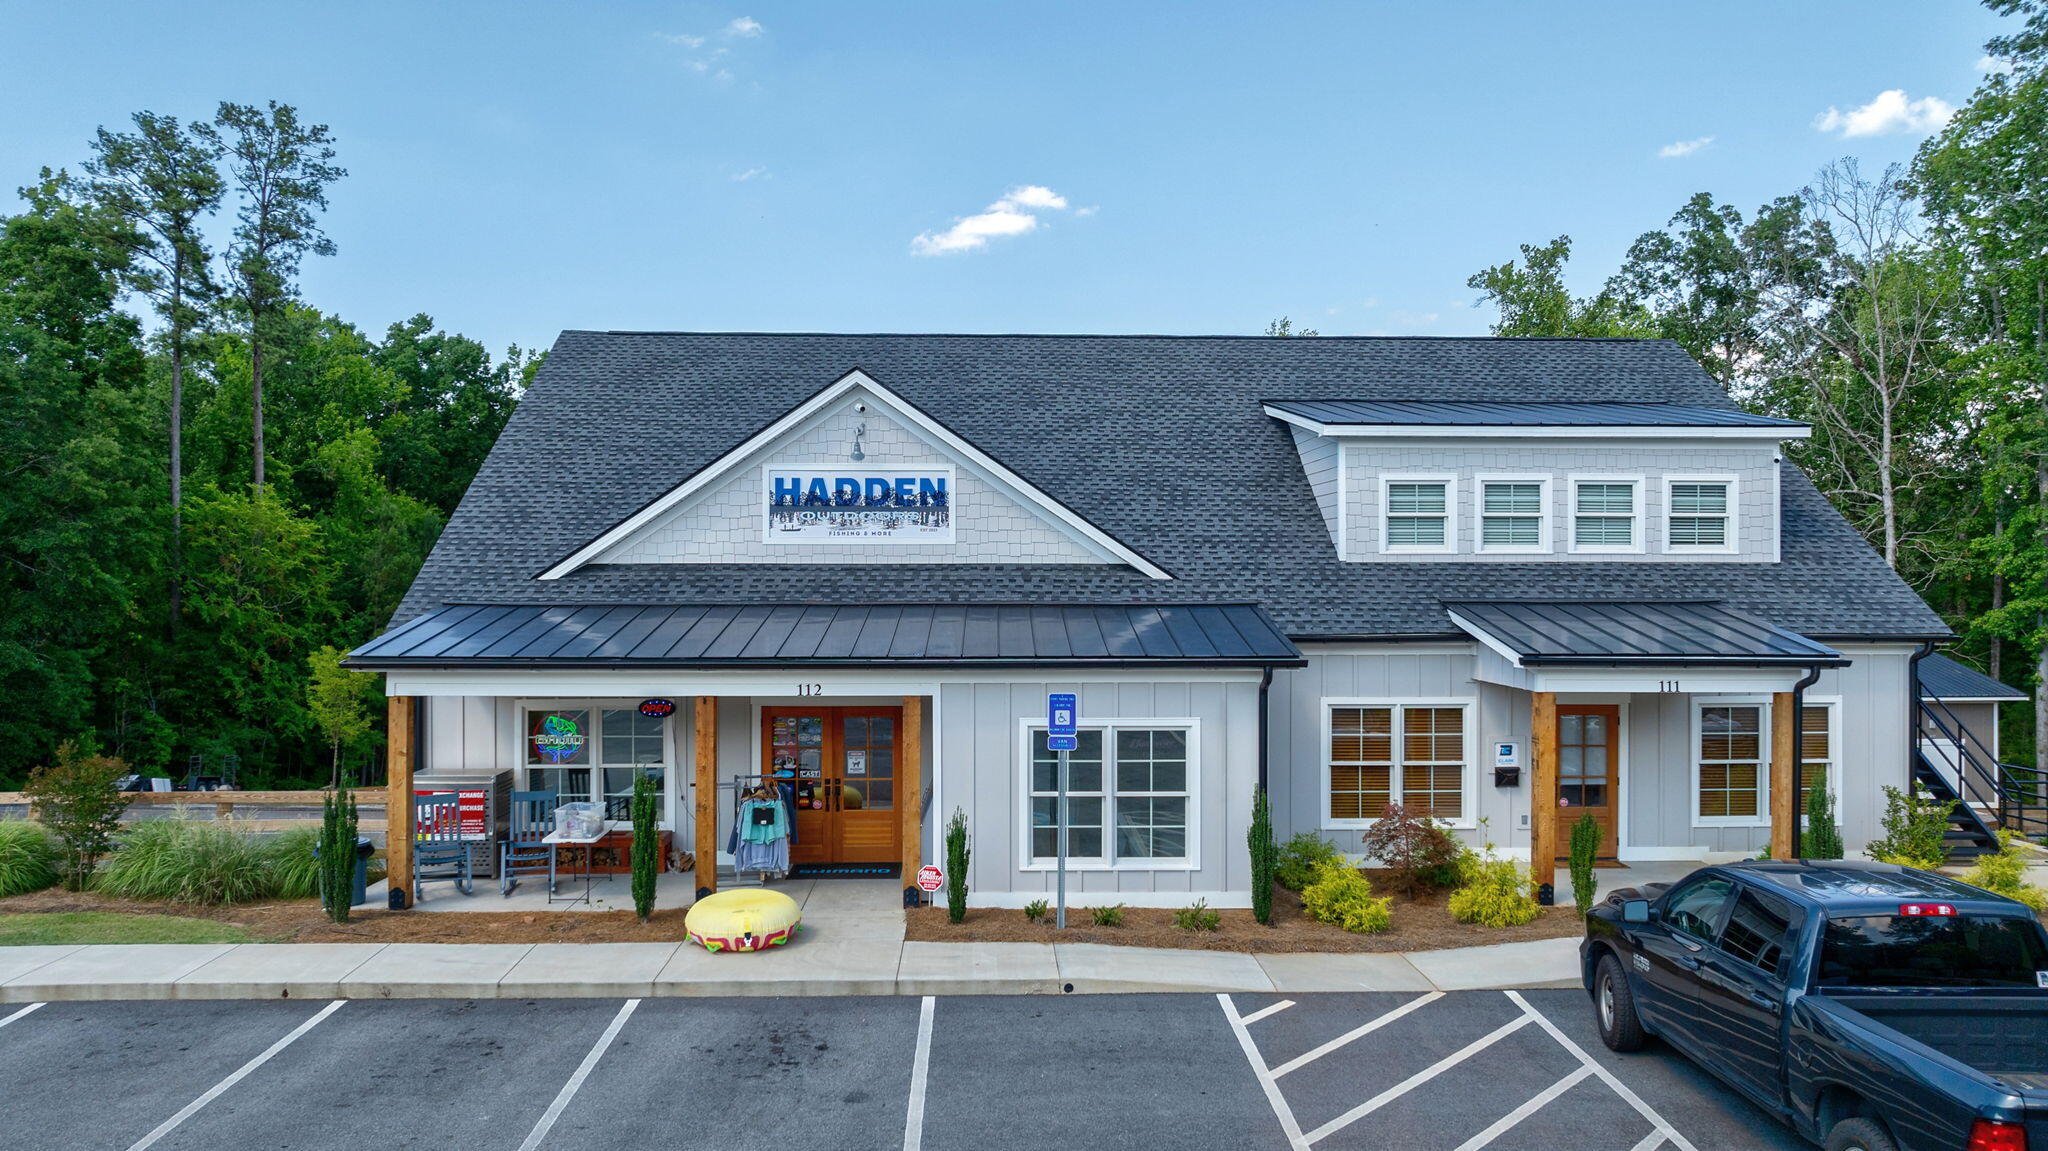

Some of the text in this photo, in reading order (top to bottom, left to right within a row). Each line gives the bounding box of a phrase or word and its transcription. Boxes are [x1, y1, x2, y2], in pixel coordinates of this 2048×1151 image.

[774, 477, 946, 507] HADDEN
[799, 511, 921, 521] OUTDOORS
[796, 683, 822, 696] 112
[1658, 680, 1680, 693] 111
[641, 704, 672, 713] OPEN
